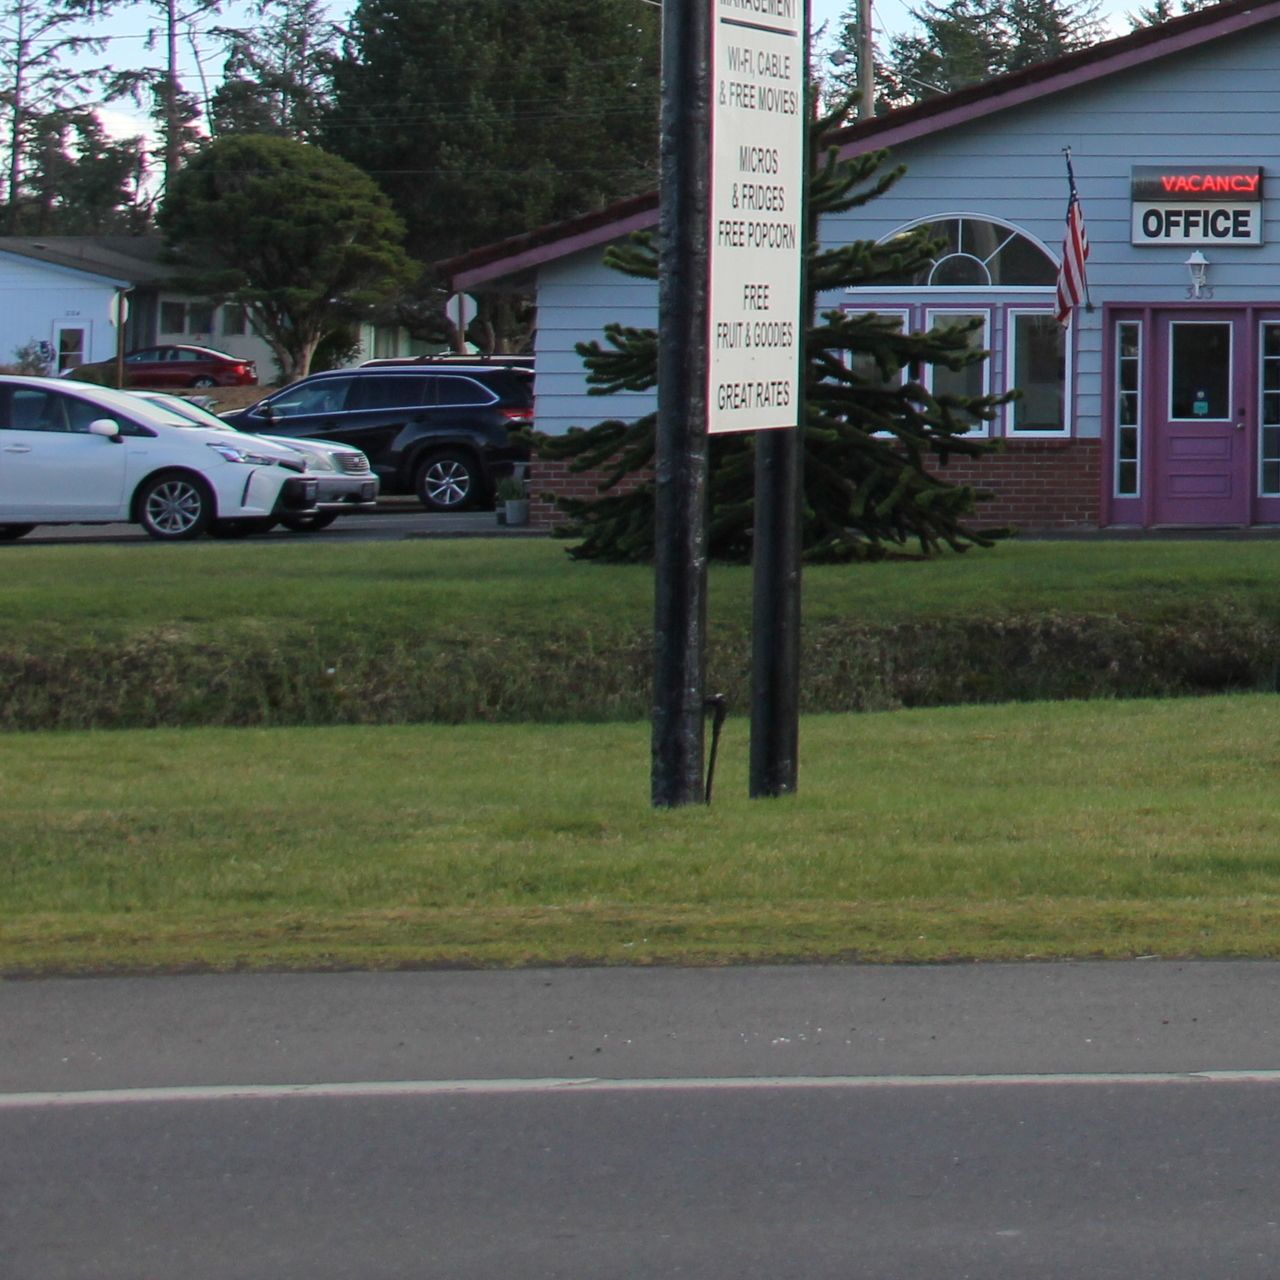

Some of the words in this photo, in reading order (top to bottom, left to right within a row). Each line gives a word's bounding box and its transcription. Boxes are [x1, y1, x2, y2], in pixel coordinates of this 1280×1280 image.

[728, 45, 755, 79] WI-FI,
[757, 51, 791, 80] CABLE
[719, 80, 726, 106] &
[729, 82, 756, 109] FREE
[758, 86, 799, 115] MOVIES!
[739, 145, 778, 174] MICROS
[732, 182, 739, 209] &
[742, 184, 785, 211] FRIDGES
[1161, 174, 1260, 192] VACANCY
[718, 220, 745, 247] FREE
[748, 222, 796, 249] POPCORN
[1142, 208, 1252, 238] OFFICE
[744, 284, 770, 310] FREE
[717, 322, 744, 348] FRUIT
[745, 322, 751, 347] &
[753, 321, 793, 348] GOODIES
[718, 383, 754, 410] GREAT
[756, 381, 790, 407] RATES
